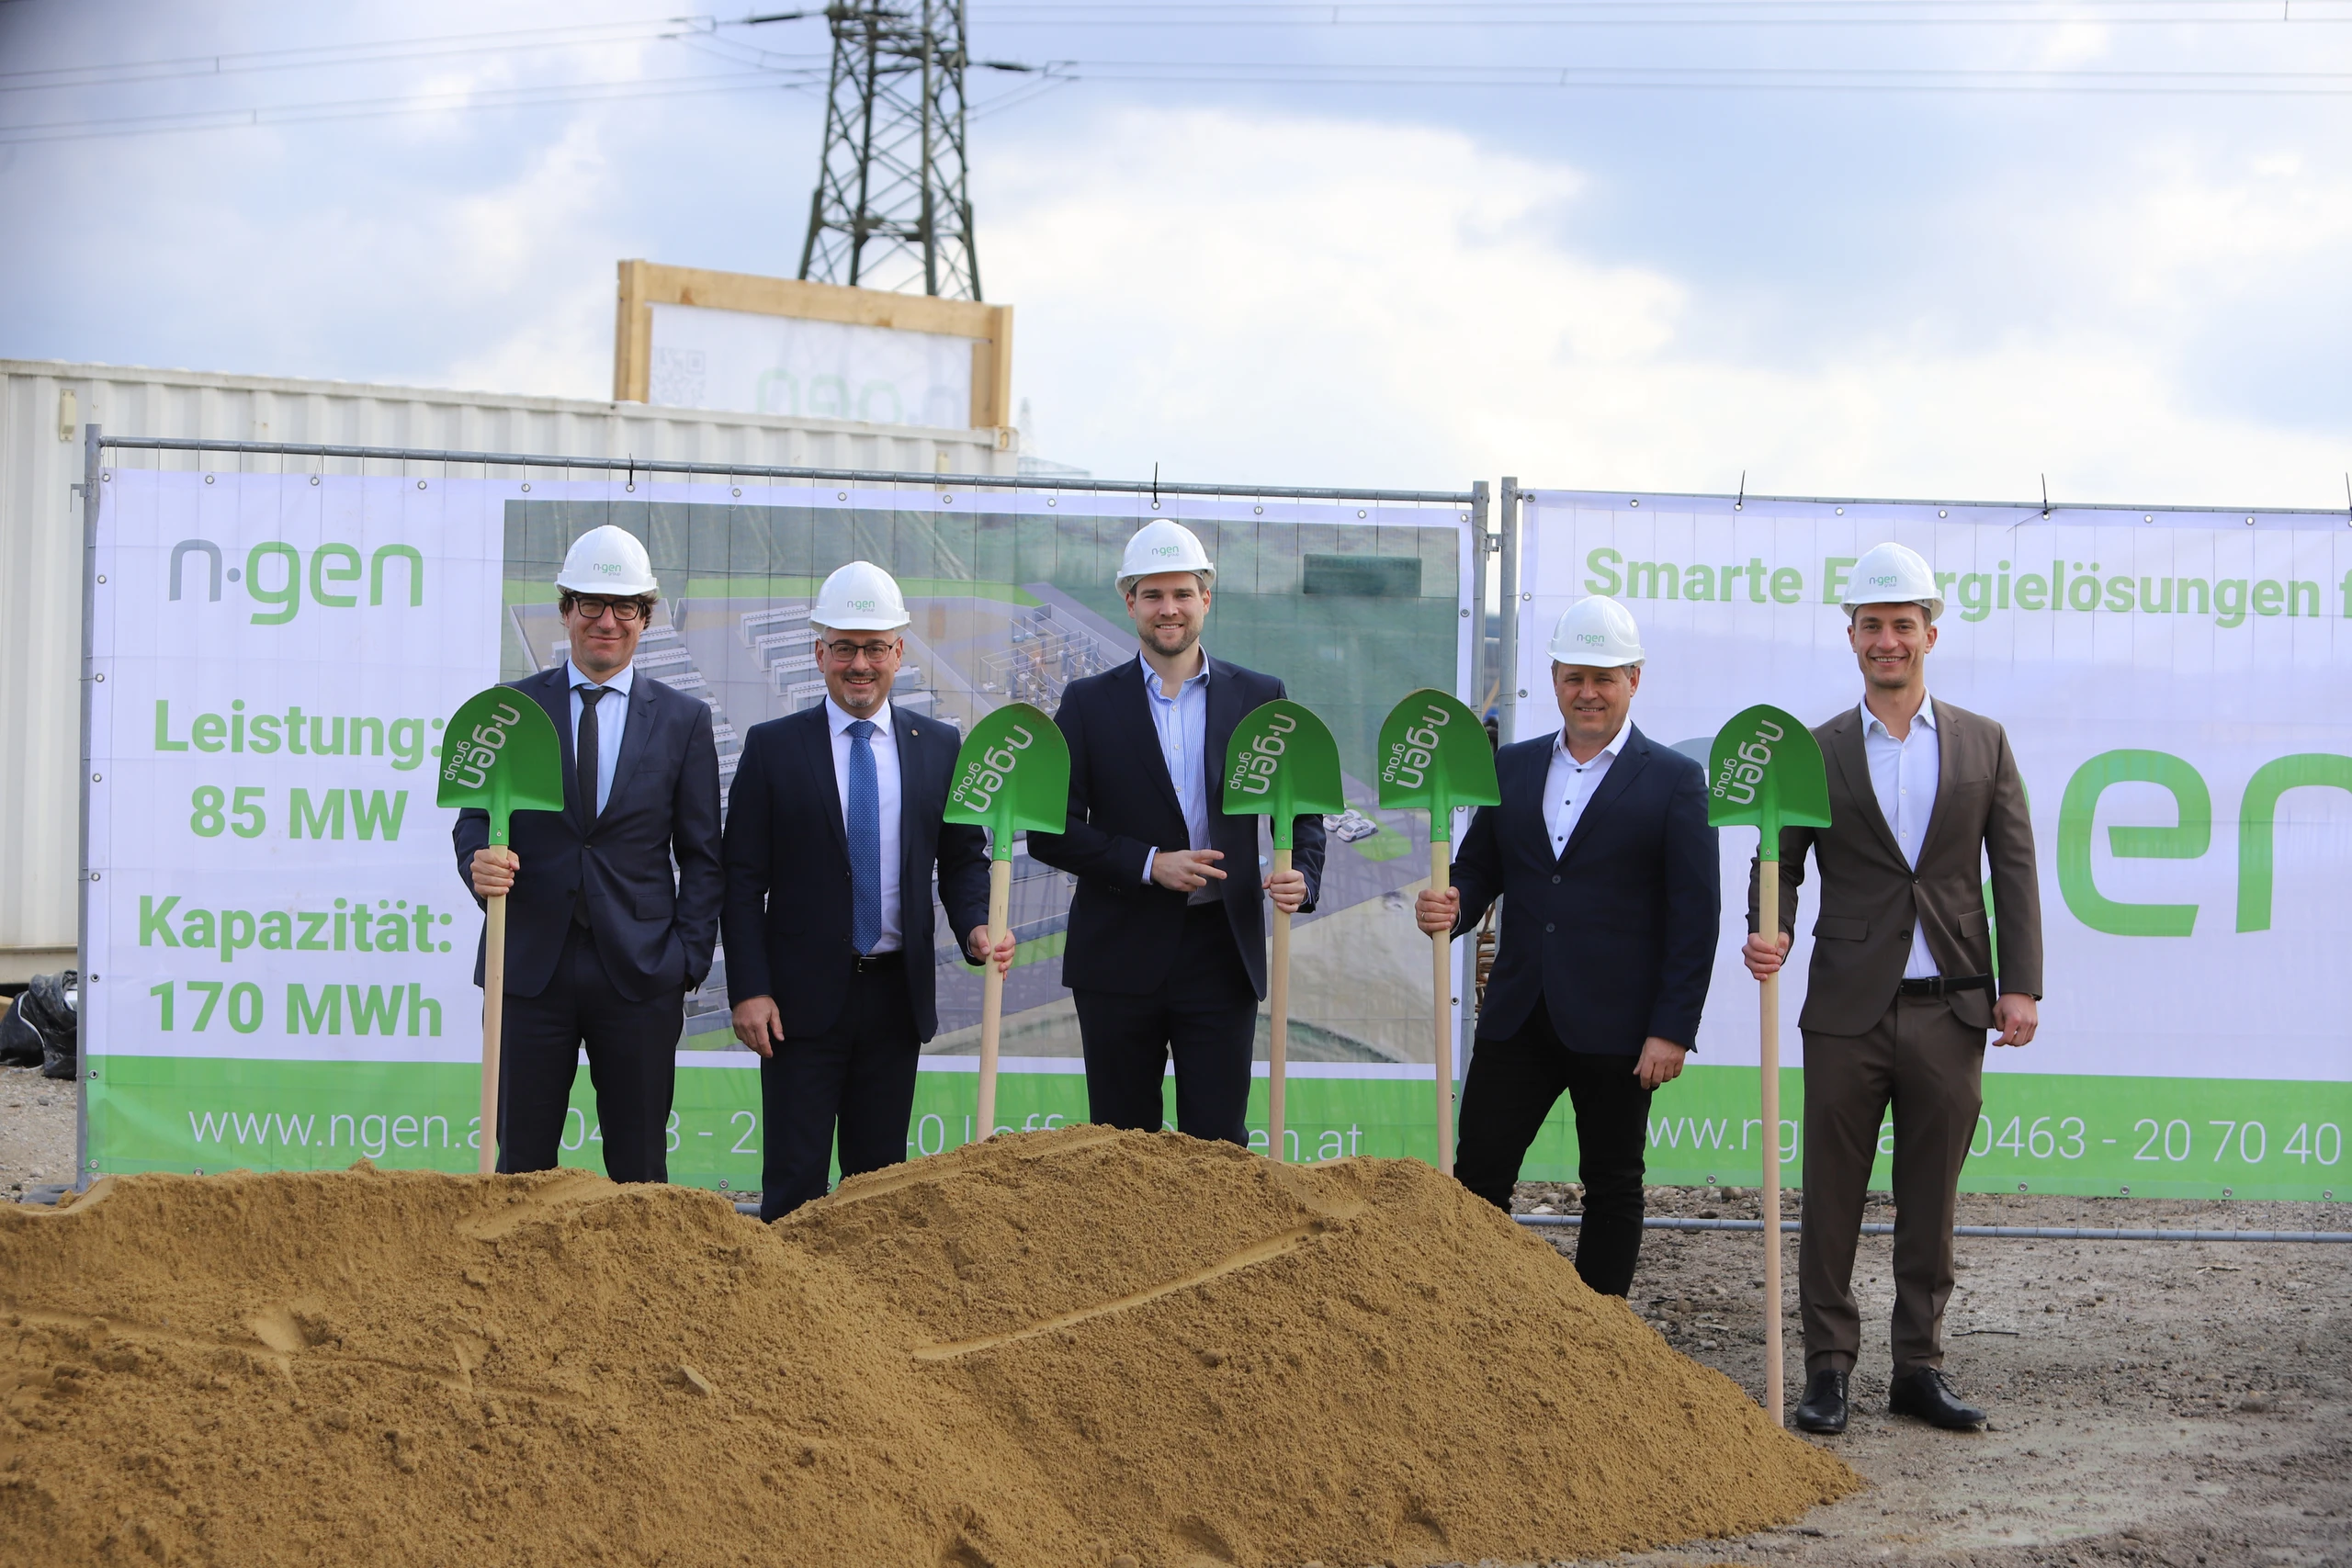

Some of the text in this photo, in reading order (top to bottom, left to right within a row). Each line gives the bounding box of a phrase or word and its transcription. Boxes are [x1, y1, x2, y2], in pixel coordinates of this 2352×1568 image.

[1583, 547, 1804, 604] Smarte
[1823, 557, 2321, 628] Ergielösungen
[155, 699, 448, 772] Leistung:
[444, 740, 471, 782] group
[952, 761, 982, 803] group
[1227, 750, 1253, 790] group
[1381, 742, 1407, 783] group
[1712, 757, 1738, 798] group
[190, 785, 409, 841] 85 MW
[139, 896, 452, 963] Kapazität:
[150, 980, 443, 1038] 170 MWh
[1969, 1113, 2086, 1159] 0463
[2133, 1118, 2191, 1162] 20
[2209, 1120, 2267, 1164] 70
[2282, 1122, 2341, 1166] 40
